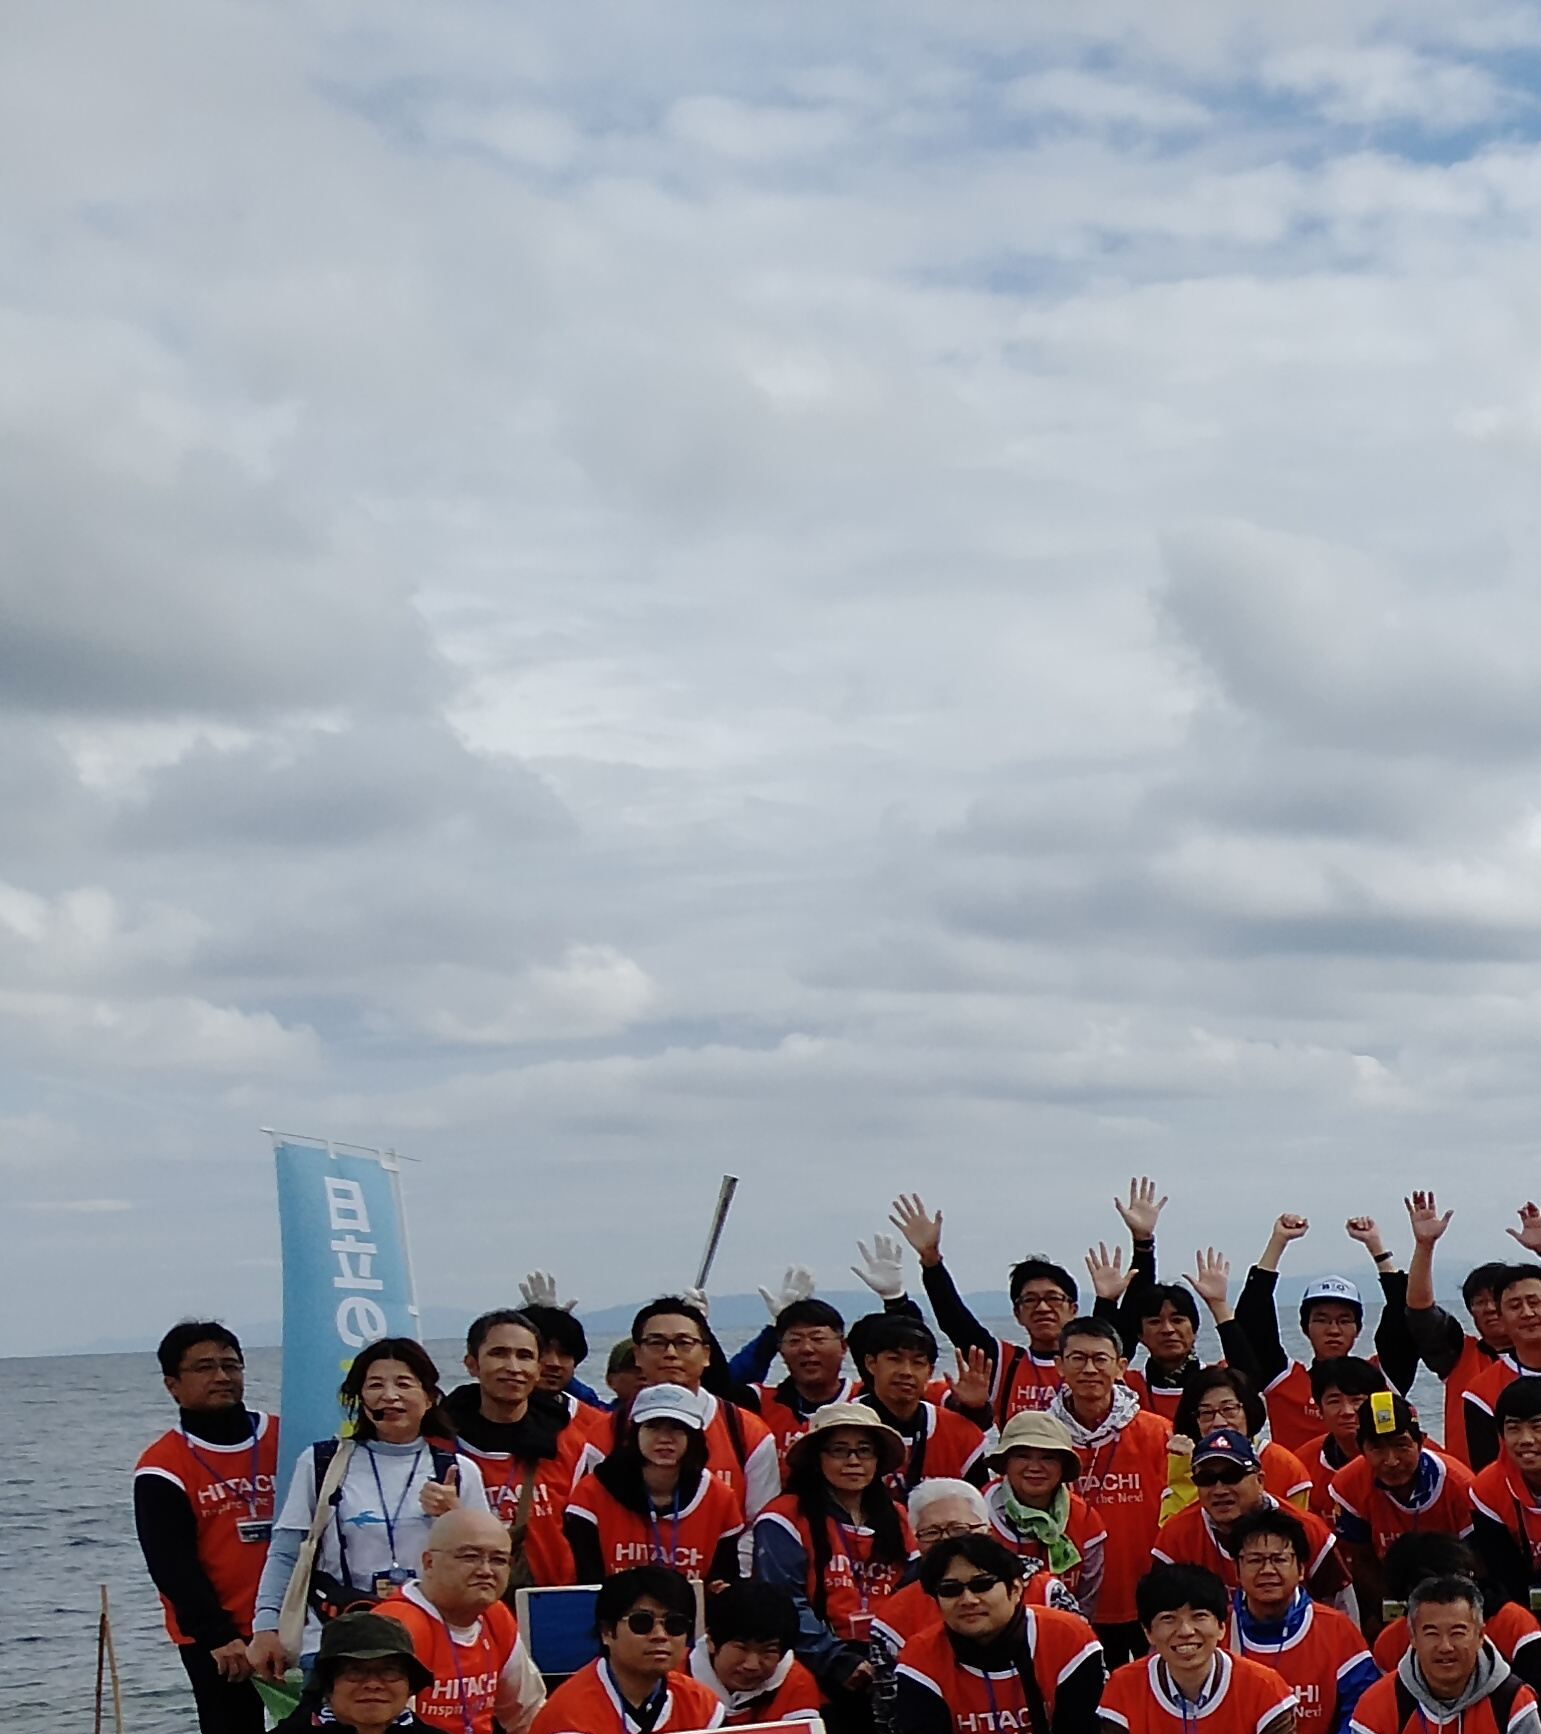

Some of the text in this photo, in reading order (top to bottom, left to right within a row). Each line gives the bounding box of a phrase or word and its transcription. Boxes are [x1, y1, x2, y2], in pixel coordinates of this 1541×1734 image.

[1016, 1385, 1057, 1400] HITA
[198, 1475, 276, 1504] HITAC
[615, 1543, 704, 1567] HITACH
[432, 1671, 498, 1699] HITACH
[956, 1707, 1032, 1733] HTAC
